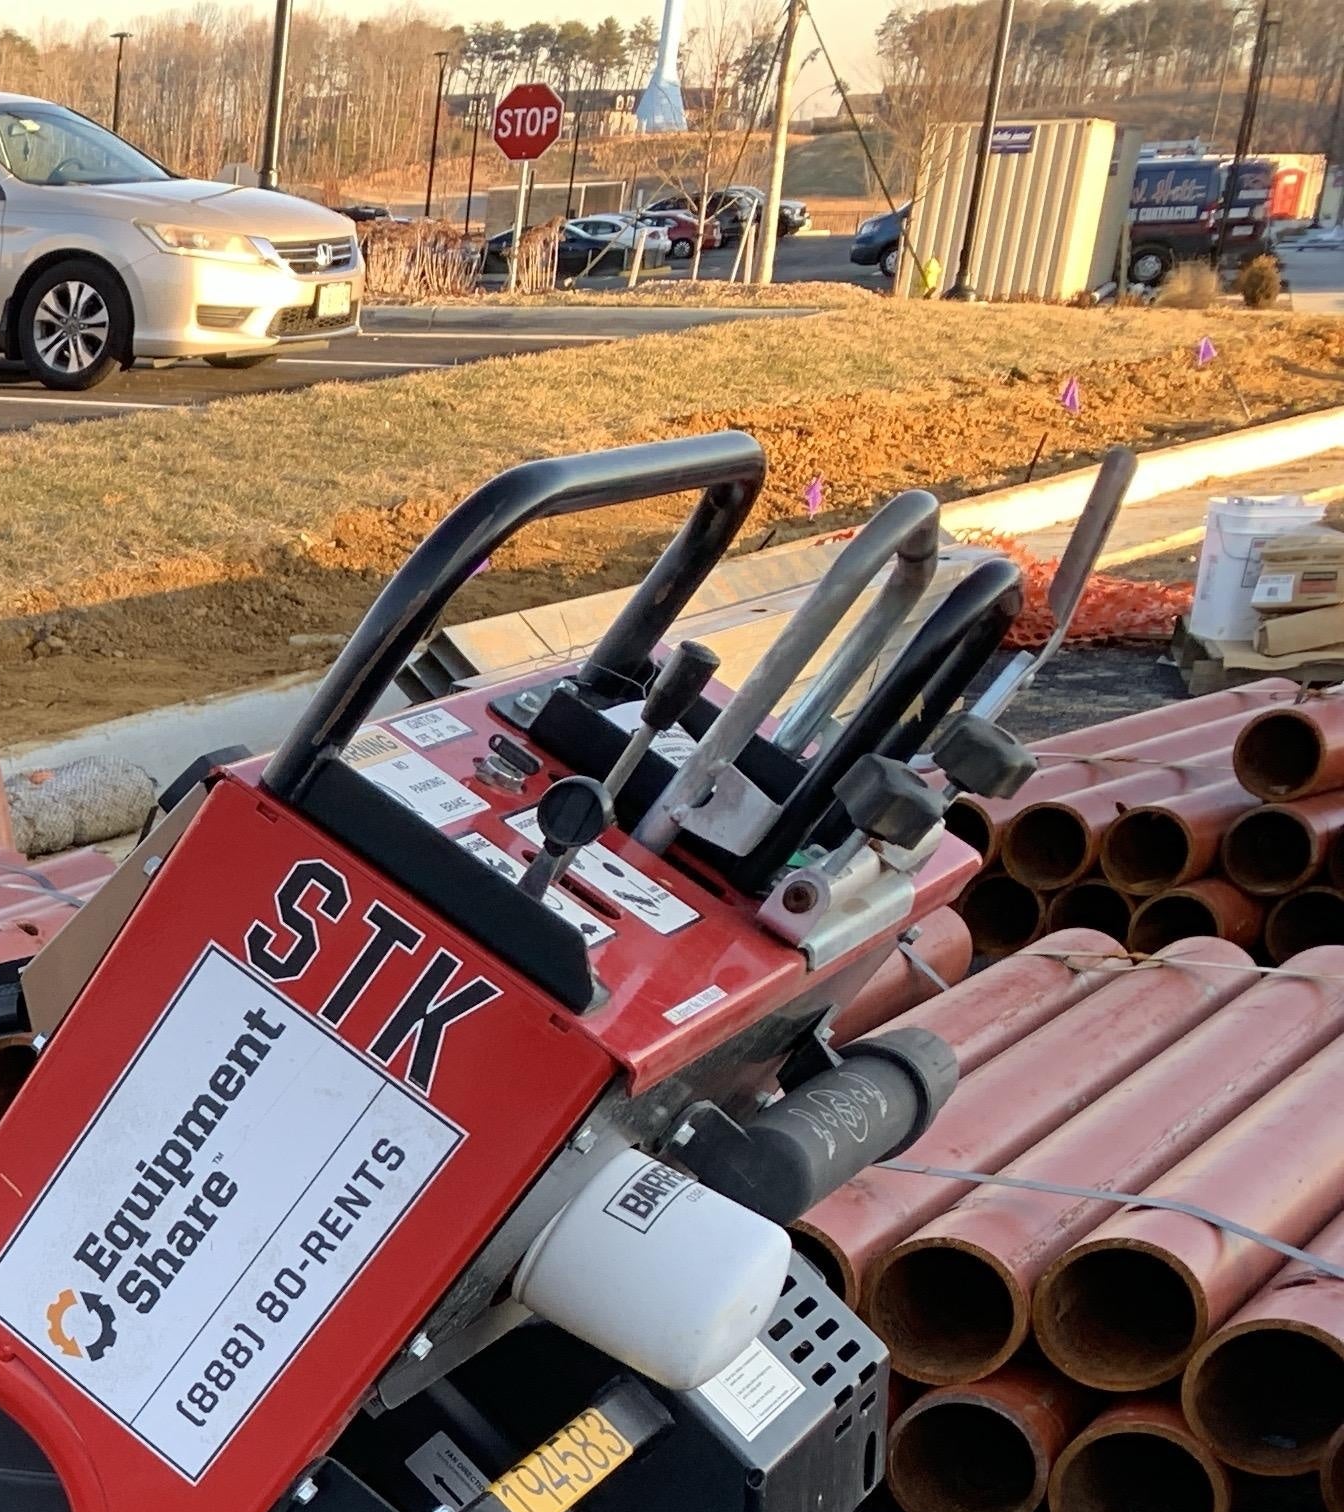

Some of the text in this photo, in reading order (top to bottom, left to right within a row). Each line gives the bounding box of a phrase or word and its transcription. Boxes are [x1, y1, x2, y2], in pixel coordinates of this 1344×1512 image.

[497, 106, 558, 139] STOP
[404, 712, 443, 730] IGNITION
[341, 734, 399, 764] ARNING
[408, 776, 447, 794] PARKING
[439, 797, 471, 813] BRAKE
[244, 859, 505, 1098] STK
[73, 1006, 286, 1283] Equipment
[117, 1170, 240, 1314] Share
[175, 1136, 408, 1428] (888) 80-RENTS
[444, 1449, 459, 1465] FAN
[457, 1462, 486, 1492] DIRECTIO
